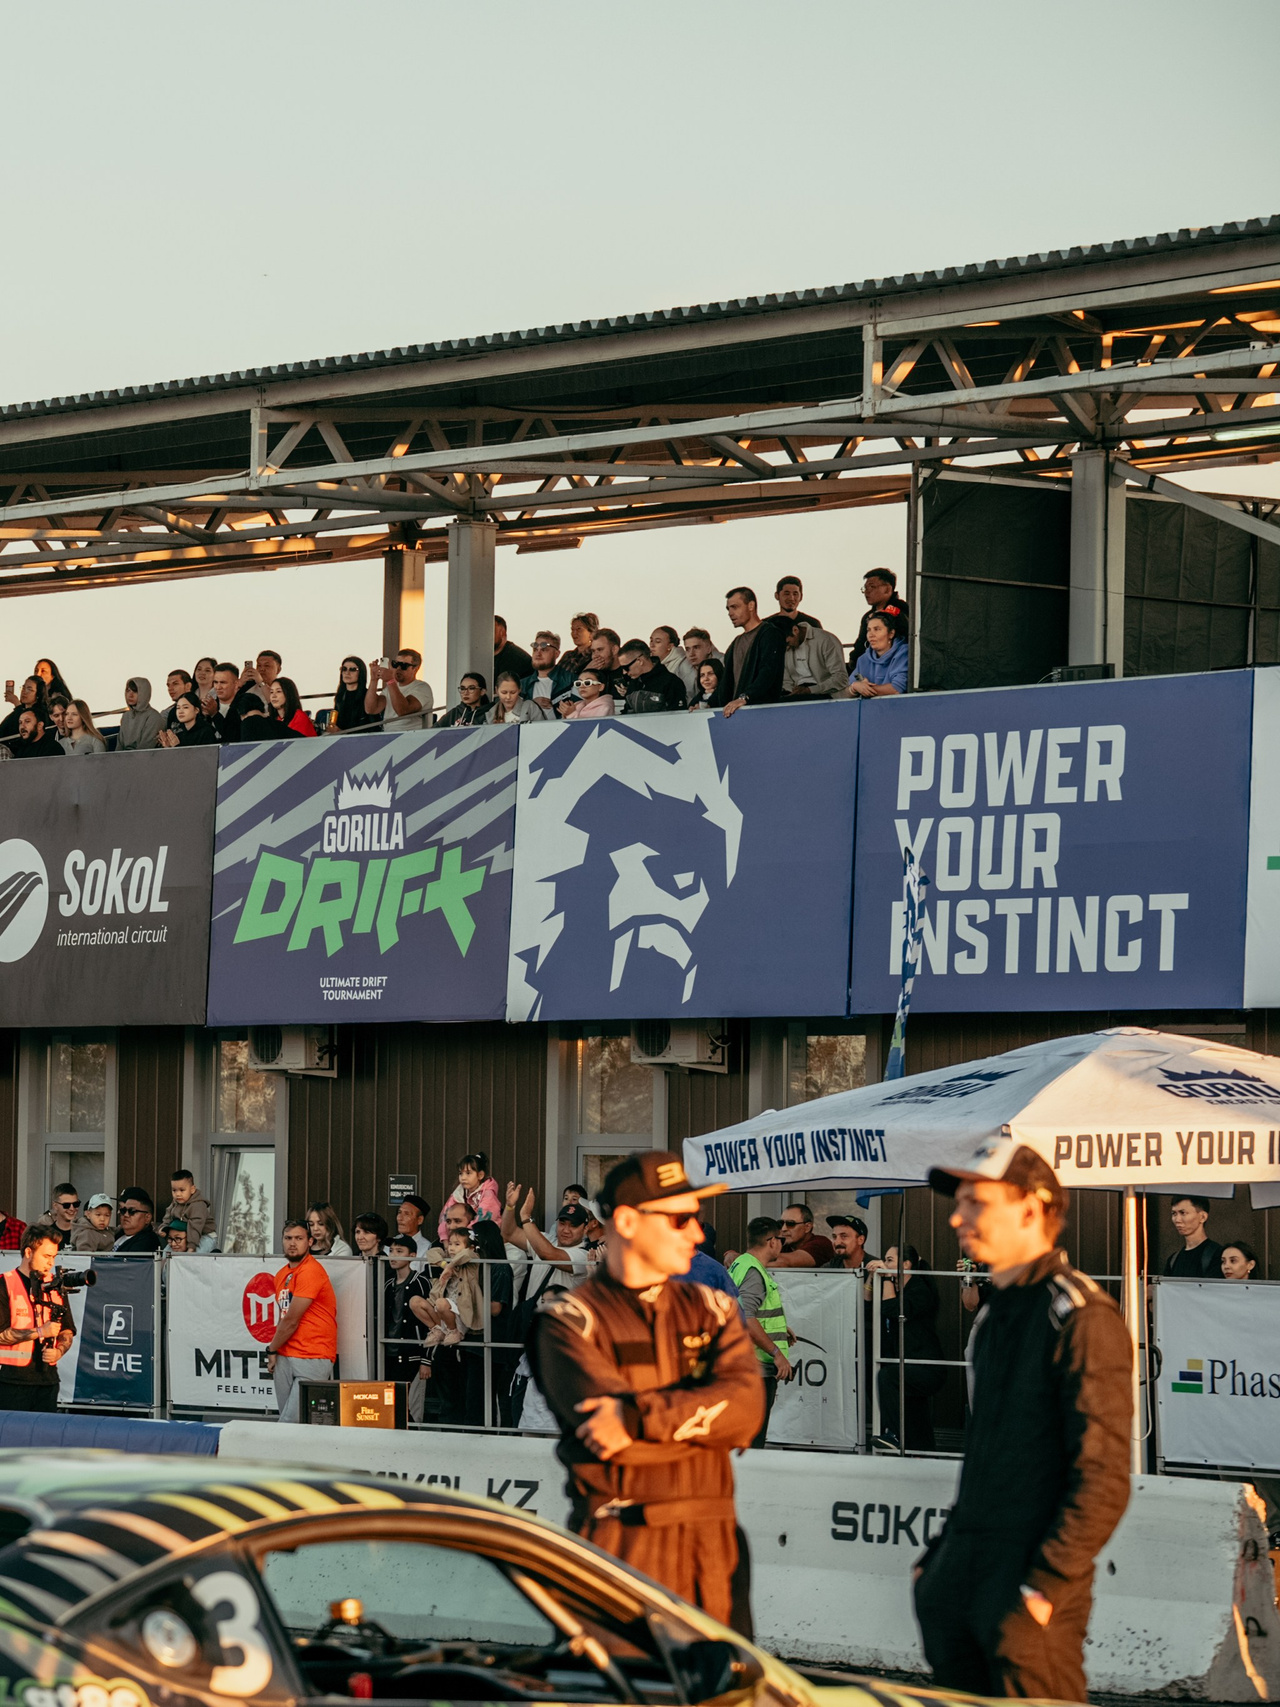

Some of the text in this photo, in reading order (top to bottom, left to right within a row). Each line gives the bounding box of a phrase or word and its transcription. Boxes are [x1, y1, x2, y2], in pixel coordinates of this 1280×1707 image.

[896, 724, 1126, 810] POWER
[323, 812, 404, 853] GORILLA
[894, 812, 1061, 891] YOUR
[57, 926, 168, 947] international circuit
[889, 893, 1189, 975] INSTINCT
[320, 976, 388, 988] ULTIMATE DRIFT
[323, 989, 383, 1000] TOURNAMENT
[704, 1128, 887, 1176] POWER YOUR INSTINCT
[1054, 1132, 1162, 1169] POWER
[1176, 1131, 1255, 1165] YOUR
[94, 1351, 142, 1373] EAE
[1207, 1359, 1280, 1399] Phas
[217, 1385, 273, 1395] FEEL THE
[190, 1570, 273, 1698] 3
